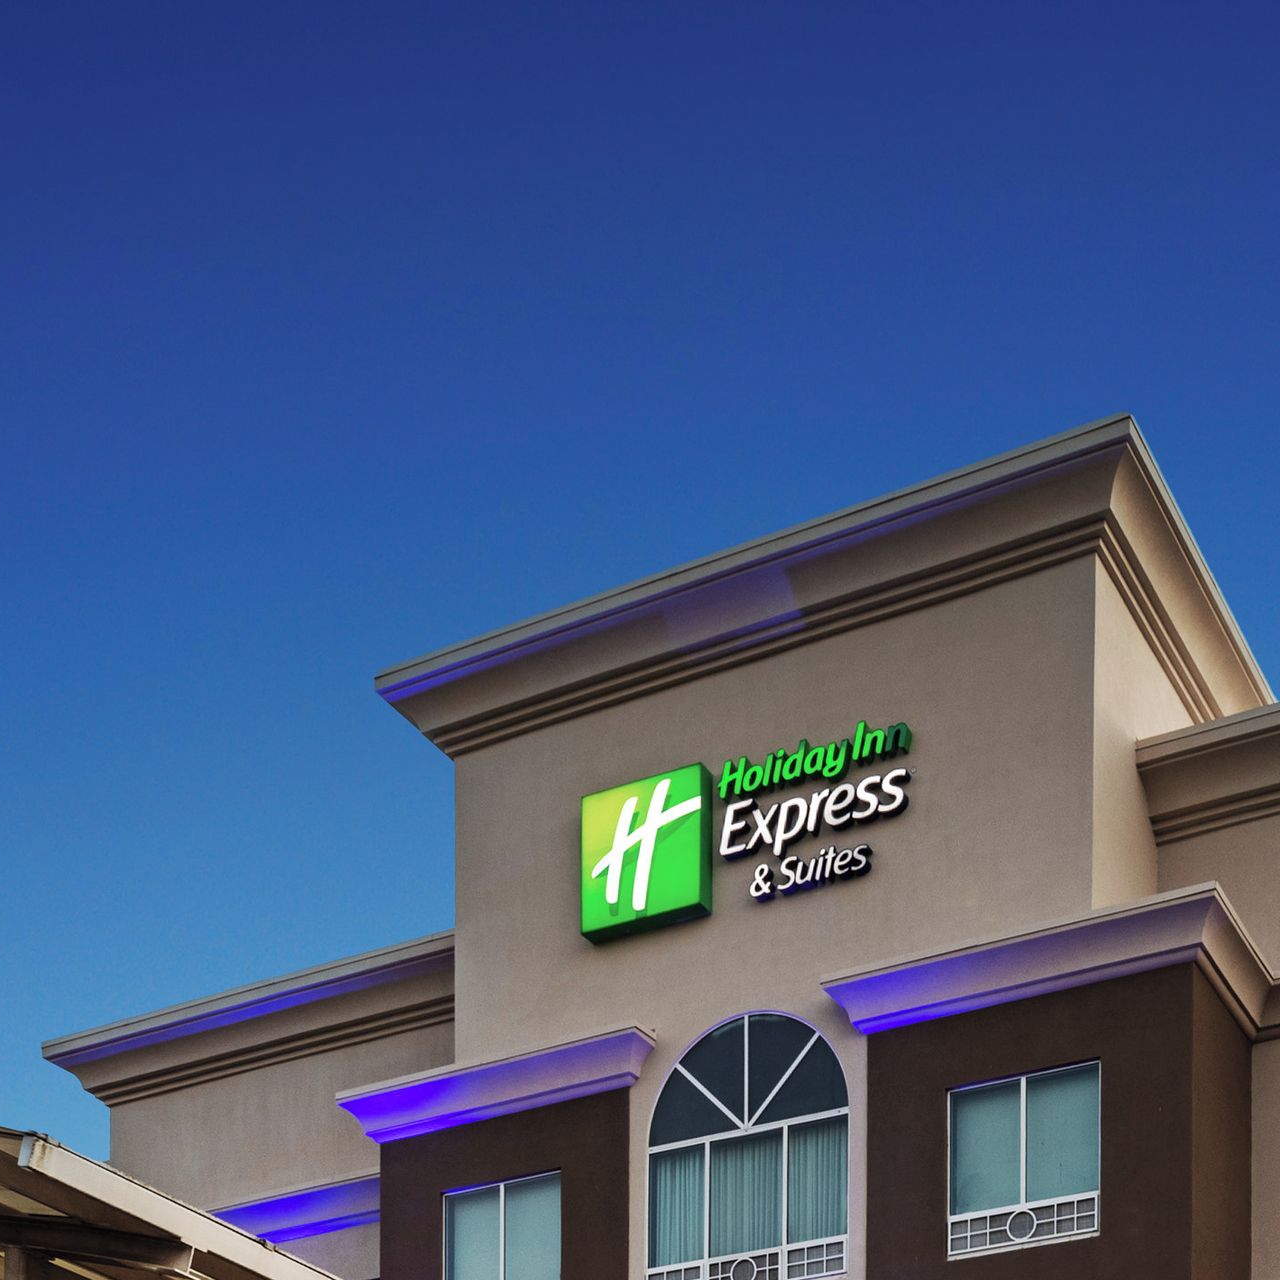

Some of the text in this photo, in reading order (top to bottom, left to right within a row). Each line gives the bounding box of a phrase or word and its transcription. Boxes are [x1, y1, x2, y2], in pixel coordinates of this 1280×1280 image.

[718, 720, 910, 800] Holiday Inn
[719, 768, 908, 857] Express
[749, 844, 870, 898] & Suites
